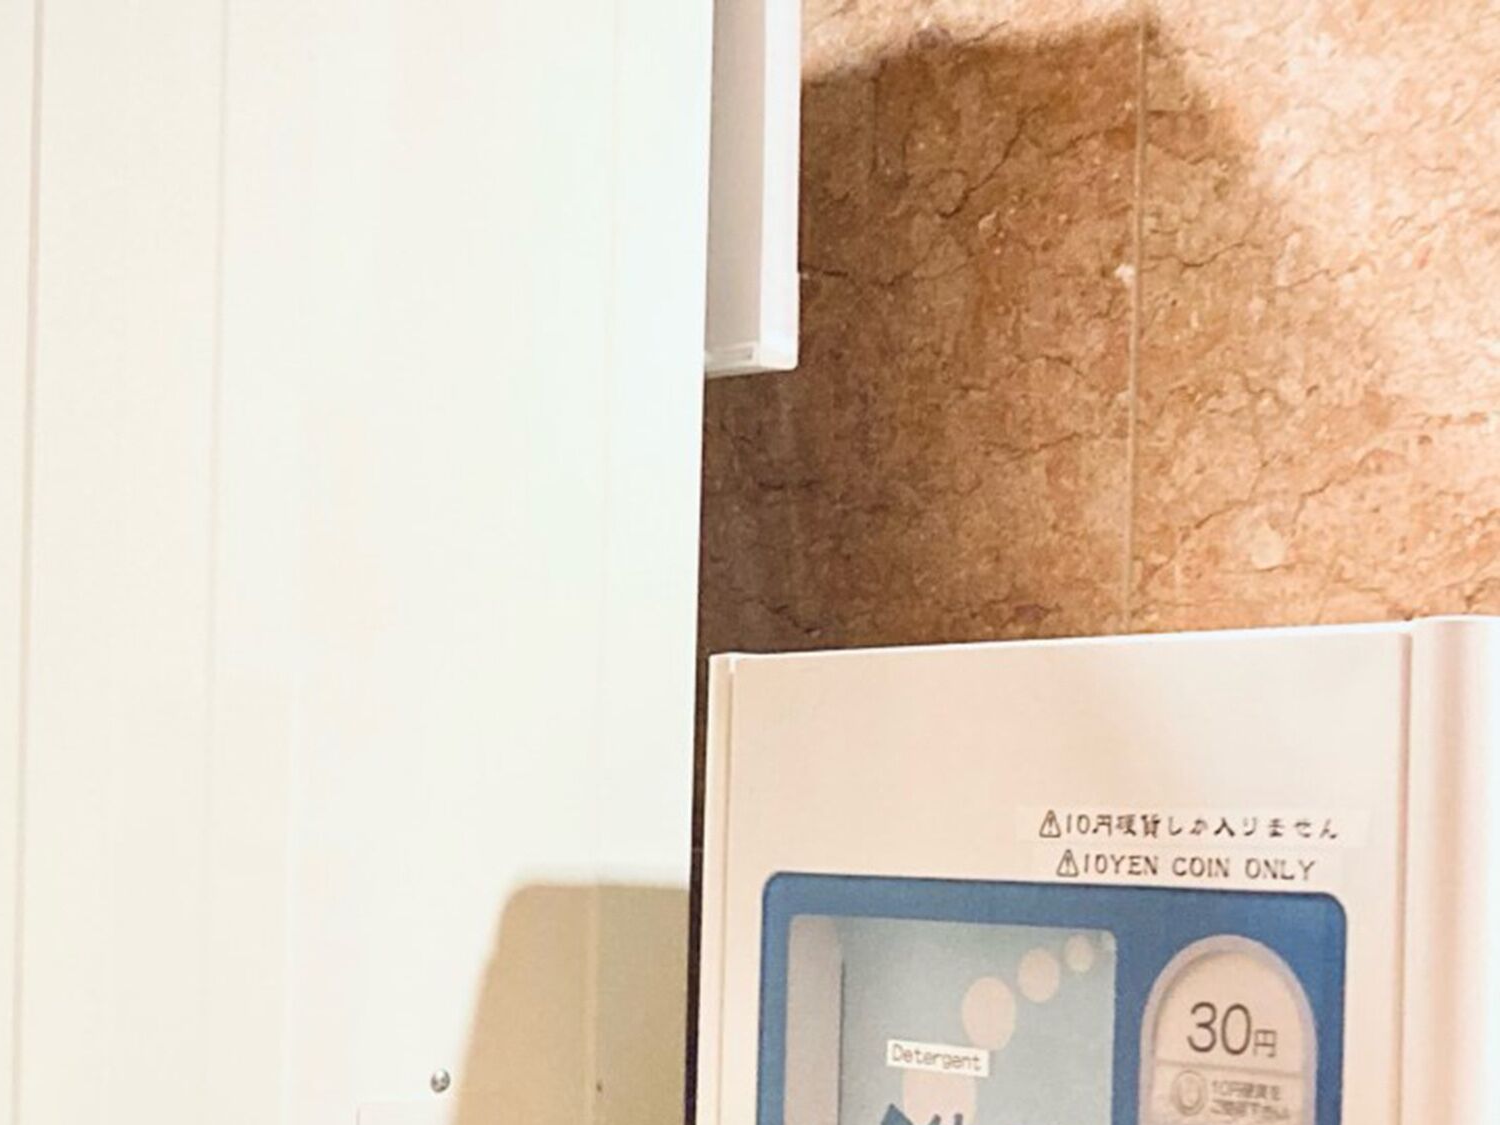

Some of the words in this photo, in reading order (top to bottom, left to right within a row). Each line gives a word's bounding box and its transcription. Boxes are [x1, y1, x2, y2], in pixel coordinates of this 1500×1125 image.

[1065, 813, 1338, 840] 10円硬貨しか入りません
[1083, 853, 1159, 876] 10YEN
[1173, 856, 1231, 878] COIN
[1245, 858, 1317, 881] ONLY
[1186, 1001, 1278, 1059] 30円
[891, 1043, 983, 1073] Detergent
